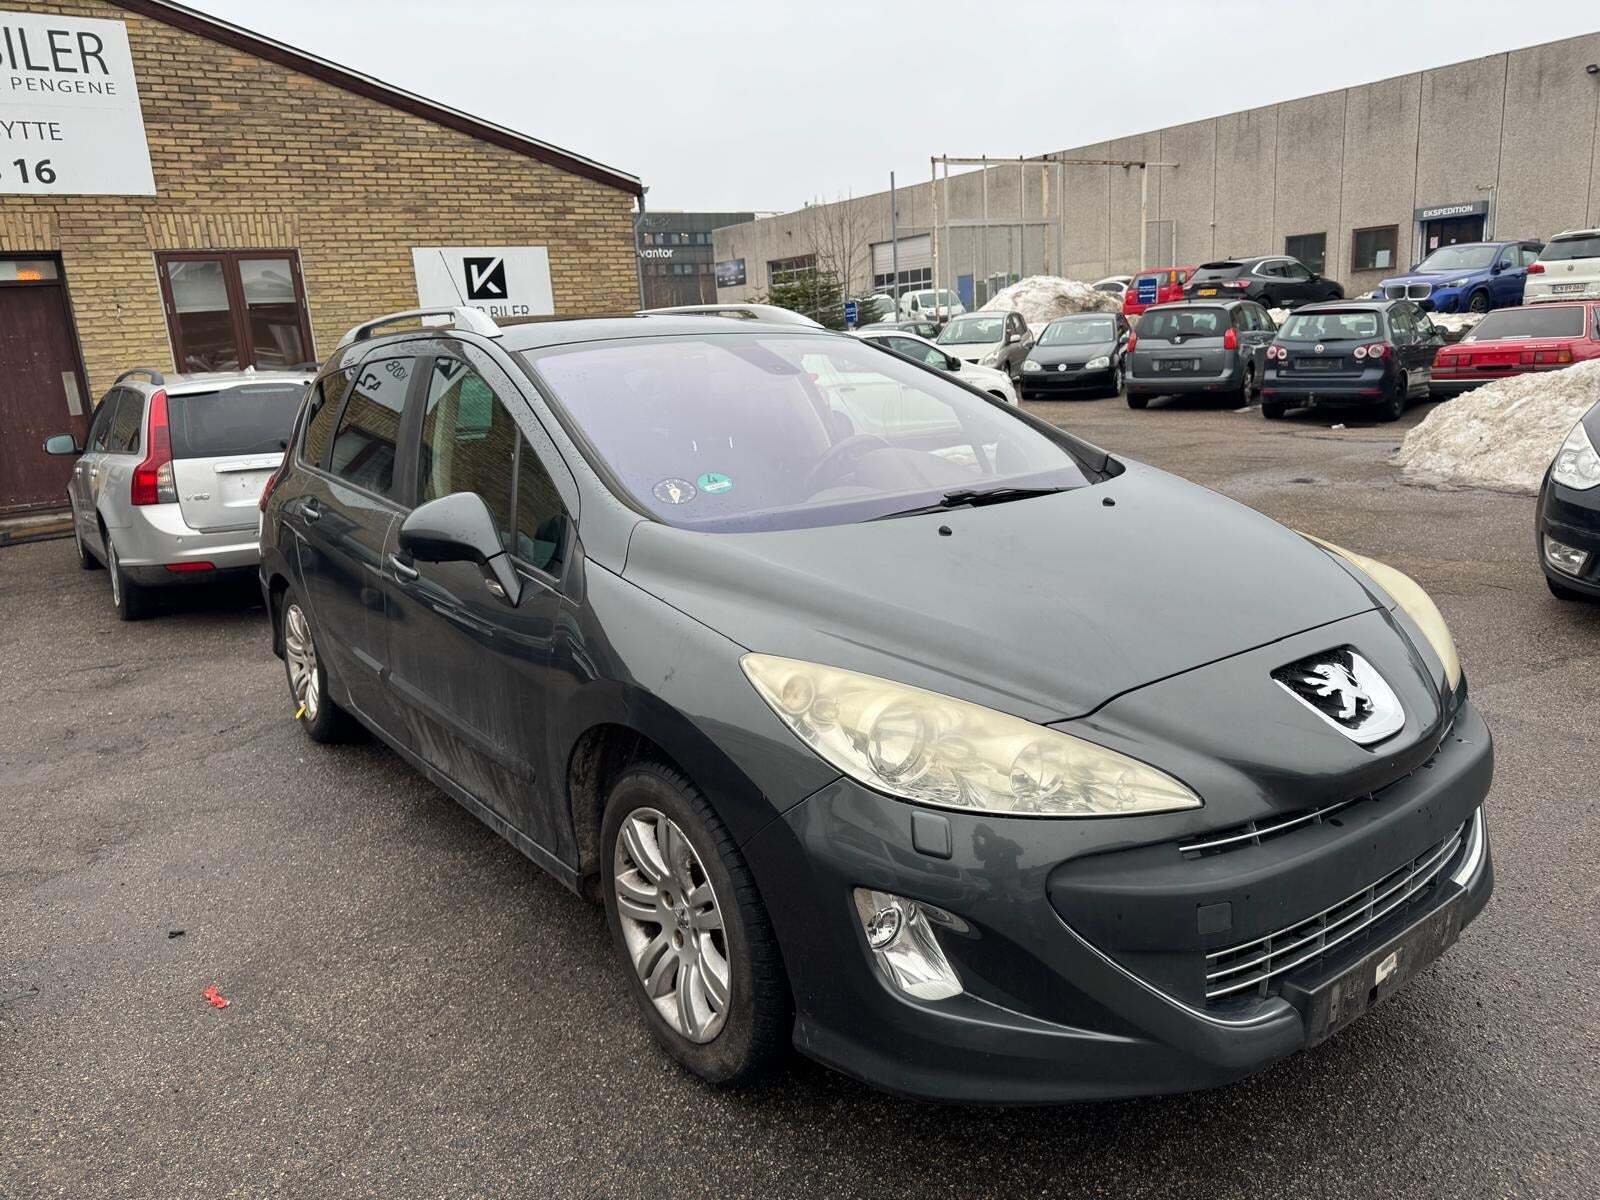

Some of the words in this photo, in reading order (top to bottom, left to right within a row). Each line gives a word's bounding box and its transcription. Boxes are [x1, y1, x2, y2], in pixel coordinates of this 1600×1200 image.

[0, 26, 109, 75] ILER
[10, 77, 116, 95] PENGENE
[0, 120, 63, 141] YTTE
[13, 158, 57, 184] 16
[1423, 204, 1473, 217] EKSPEDITION
